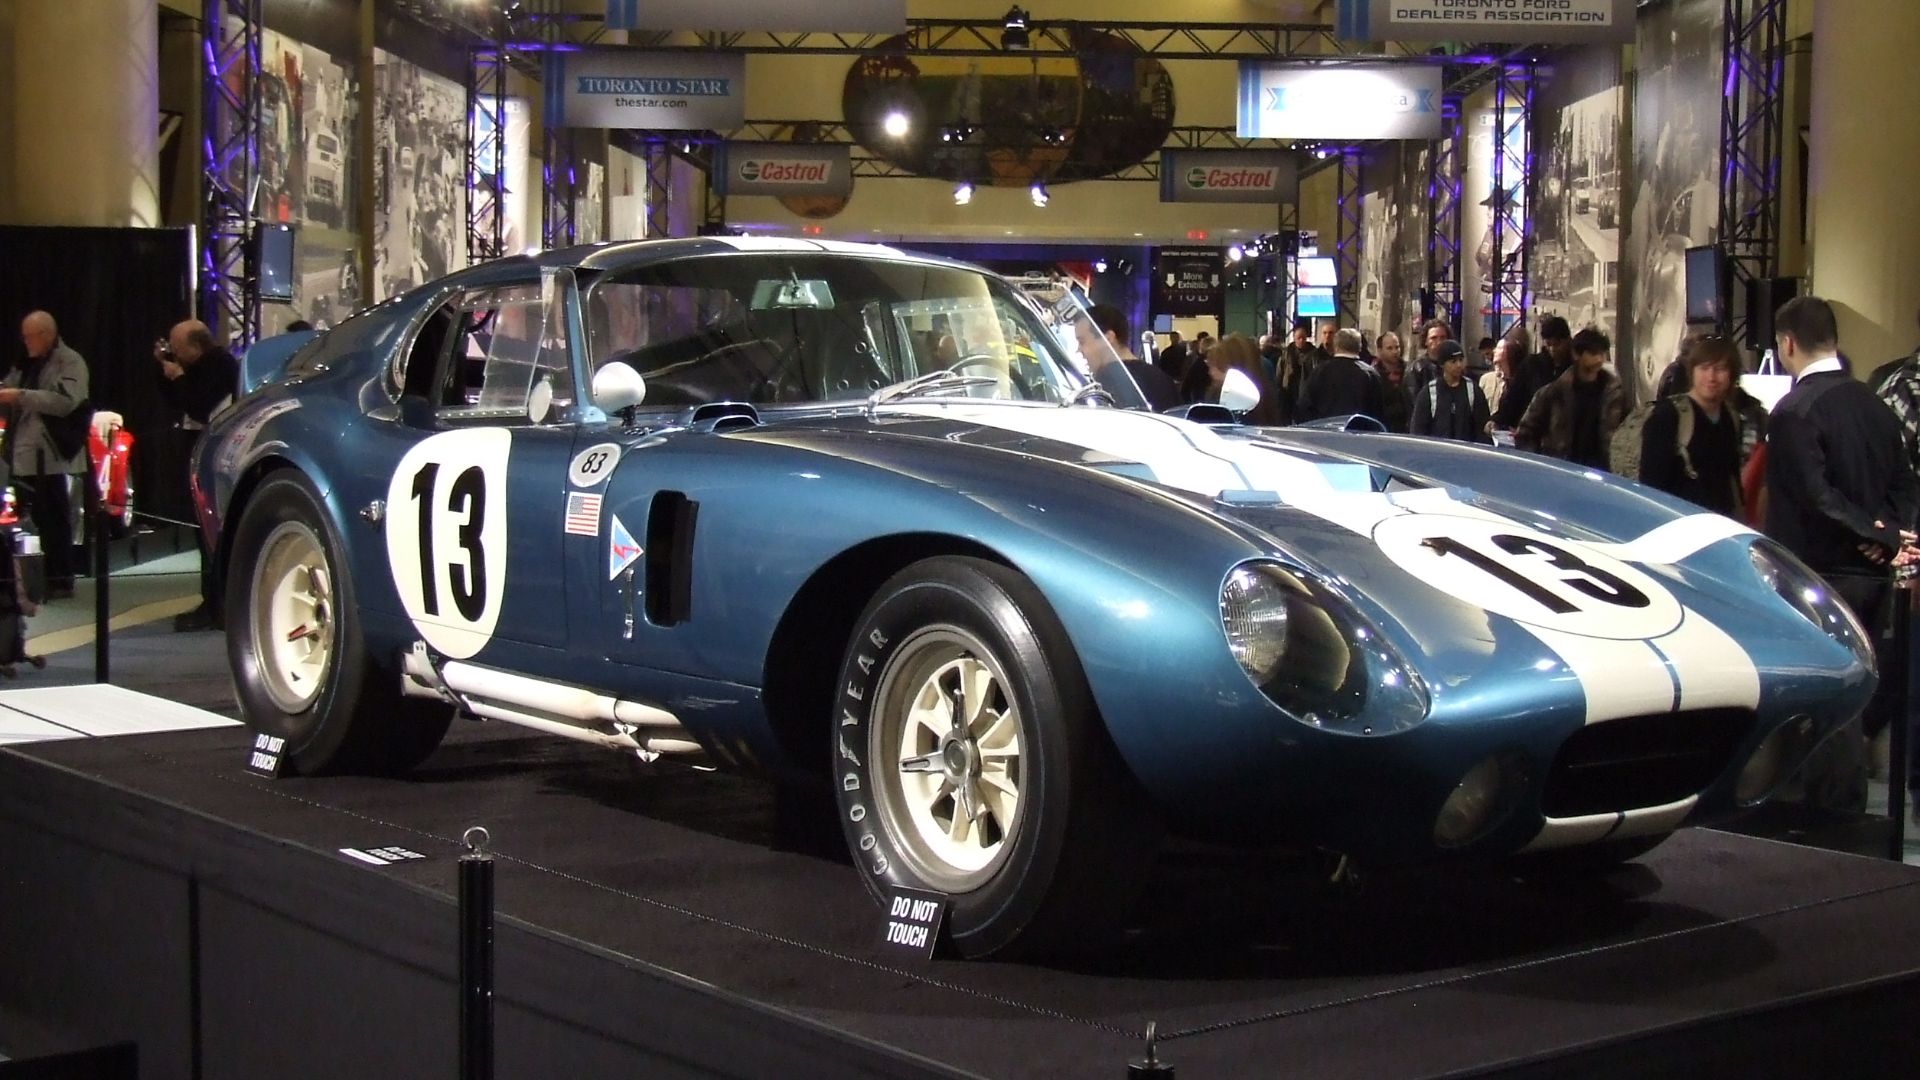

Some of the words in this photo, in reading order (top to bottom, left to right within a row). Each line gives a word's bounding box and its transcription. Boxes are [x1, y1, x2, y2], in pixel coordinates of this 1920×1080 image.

[1433, 0, 1516, 8] TORONTO
[1523, 0, 1571, 9] FORD
[1396, 9, 1477, 20] DEALERS
[1484, 10, 1605, 22] ASSOCIATION
[585, 78, 671, 93] TORONTO
[676, 80, 722, 94] STAR
[615, 97, 688, 108] thestar.com
[760, 161, 827, 181] Castrol
[1208, 168, 1273, 188] Castrol
[1178, 281, 1208, 289] Exhibits
[1183, 272, 1203, 281] More
[581, 452, 608, 474] 83
[411, 462, 486, 622] 13
[1419, 534, 1651, 614] 13
[255, 733, 270, 750] DO
[266, 736, 285, 753] NOT
[839, 628, 889, 875] GOODYEAR
[251, 751, 278, 771] TOUCH
[890, 896, 911, 918] DO
[910, 899, 939, 923] NOT
[886, 921, 929, 948] TOUCH
